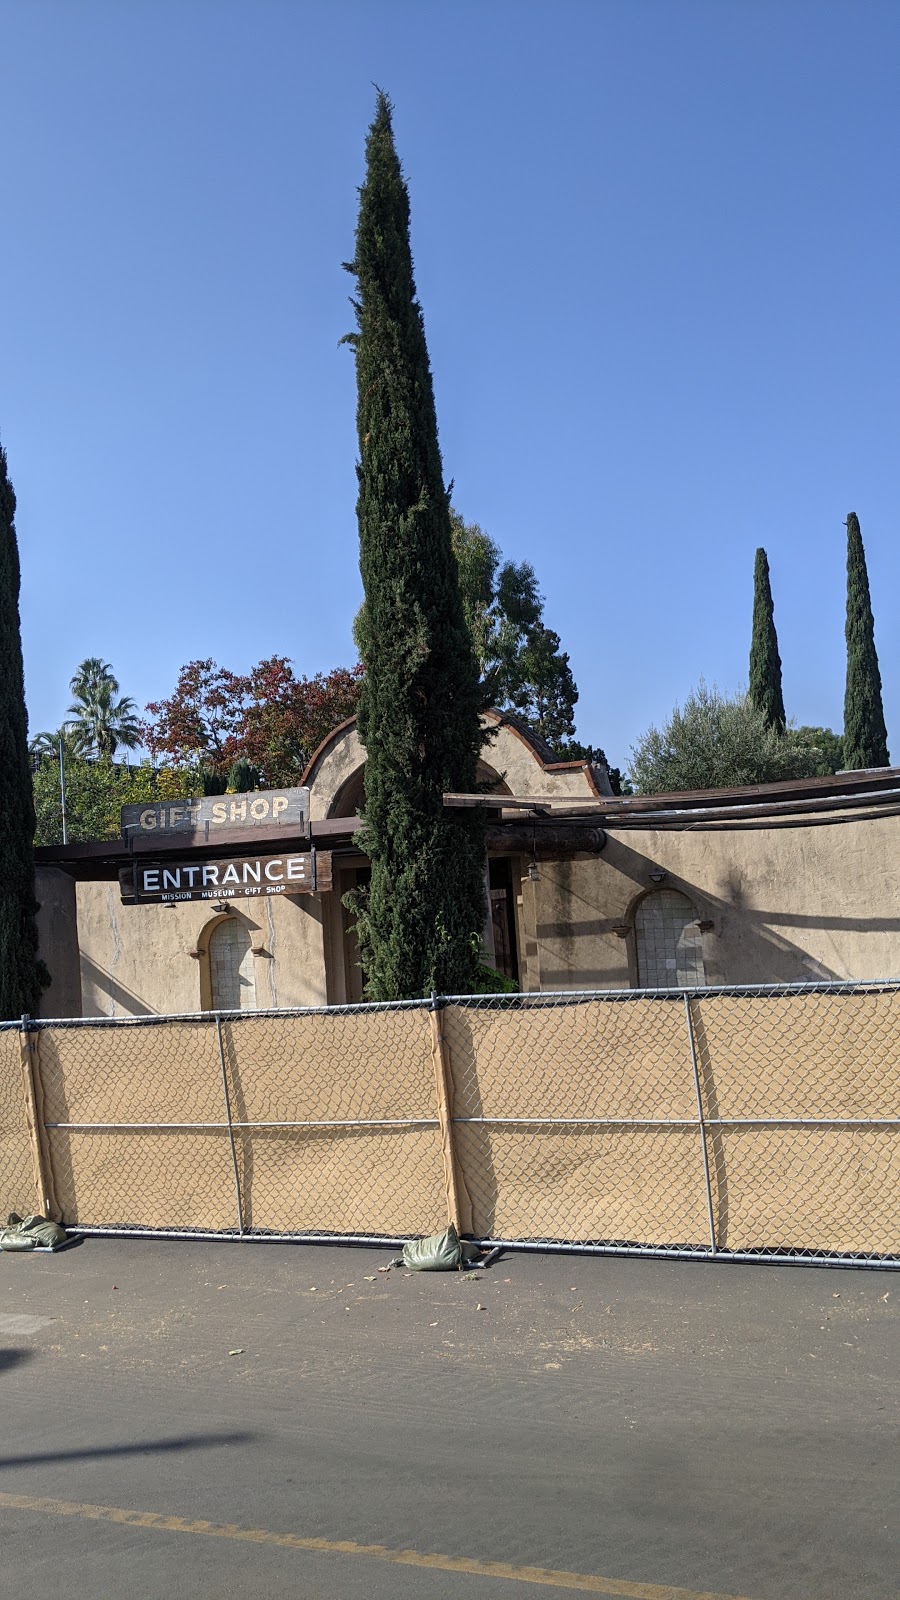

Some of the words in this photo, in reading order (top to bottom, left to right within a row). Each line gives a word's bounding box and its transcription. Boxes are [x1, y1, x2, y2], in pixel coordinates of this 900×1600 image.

[139, 804, 202, 830] GIFT
[211, 796, 289, 824] SHOP
[143, 857, 305, 891] ENTRANCE
[161, 892, 192, 901] MISSION
[201, 889, 235, 898] MUSEUM
[244, 886, 262, 895] GIFT
[266, 885, 286, 893] SHOP
